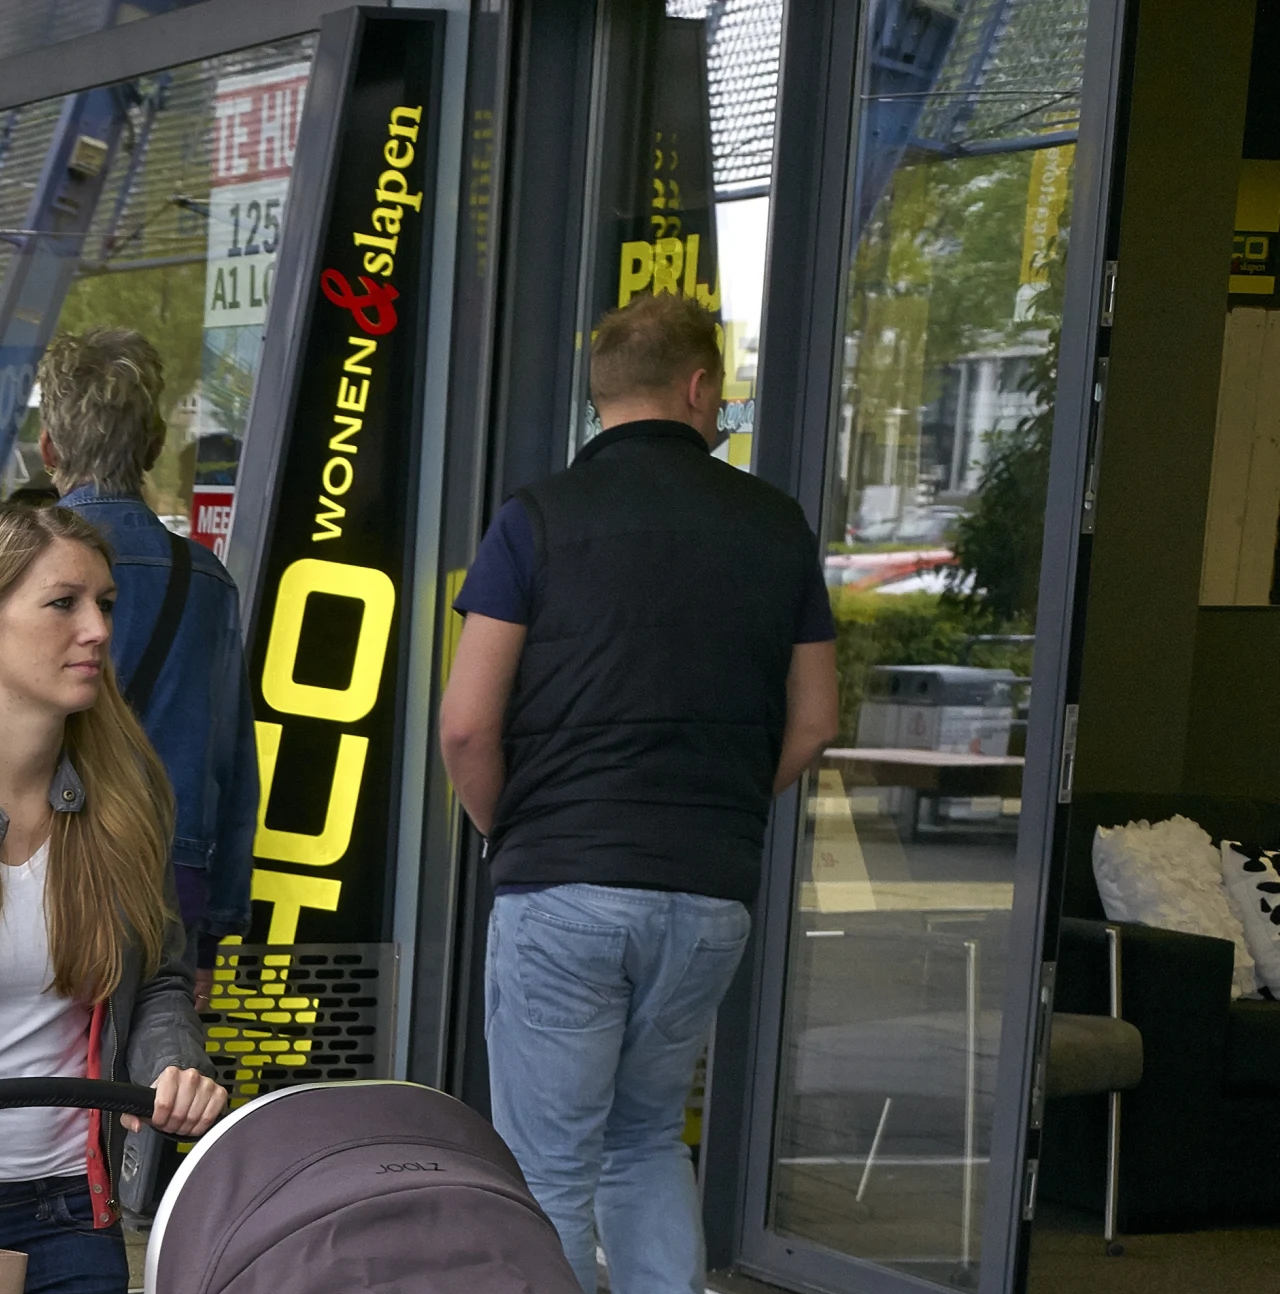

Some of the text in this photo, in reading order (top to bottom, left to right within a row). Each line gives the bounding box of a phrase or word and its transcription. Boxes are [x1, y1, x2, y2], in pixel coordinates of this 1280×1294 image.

[215, 85, 308, 177] TE HU
[228, 198, 281, 257] 125
[211, 263, 241, 311] A1
[312, 105, 422, 541] WONEN & slapen
[197, 505, 231, 534] MEE
[375, 1162, 447, 1175] JOOLZ
